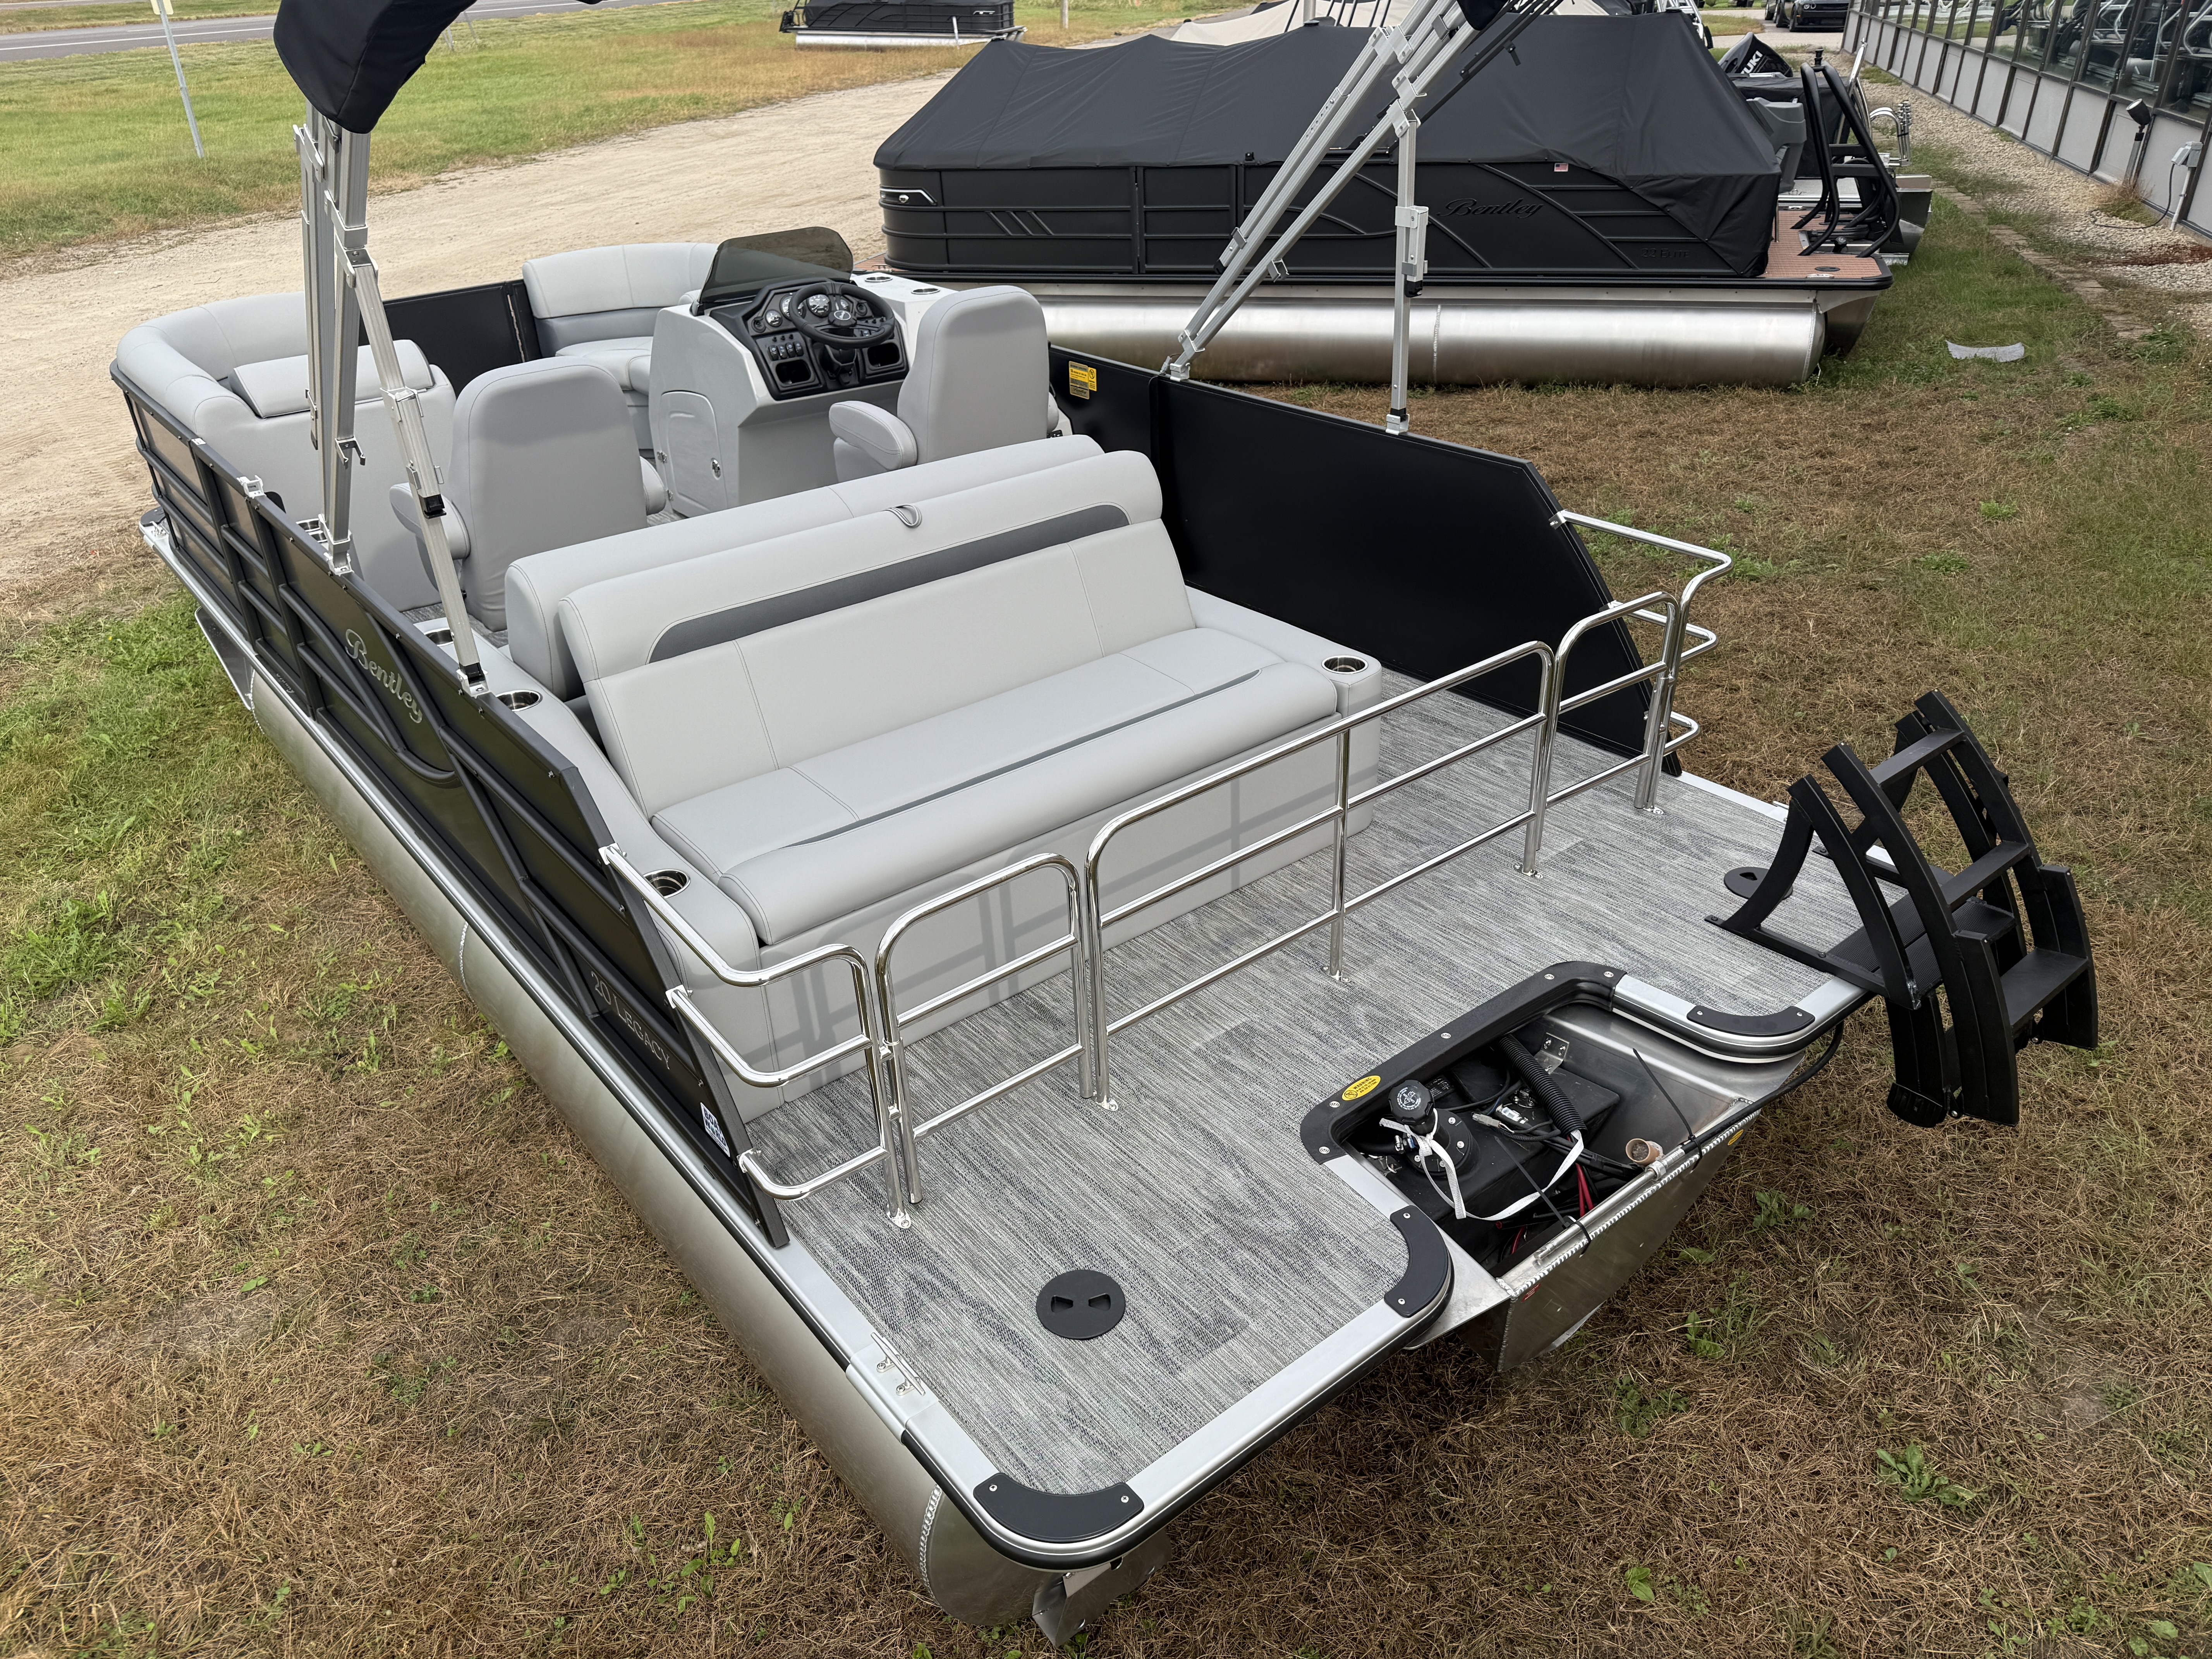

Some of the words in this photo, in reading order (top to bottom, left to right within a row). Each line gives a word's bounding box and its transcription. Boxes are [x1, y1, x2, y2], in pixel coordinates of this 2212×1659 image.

[1740, 50, 1763, 74] UKI
[1437, 198, 1544, 218] Bentley
[1641, 248, 1657, 258] 22
[345, 629, 422, 723] Bentley
[591, 971, 611, 1005] 20
[613, 993, 670, 1070] LEGACY
[1353, 1077, 1372, 1089] WARNING
